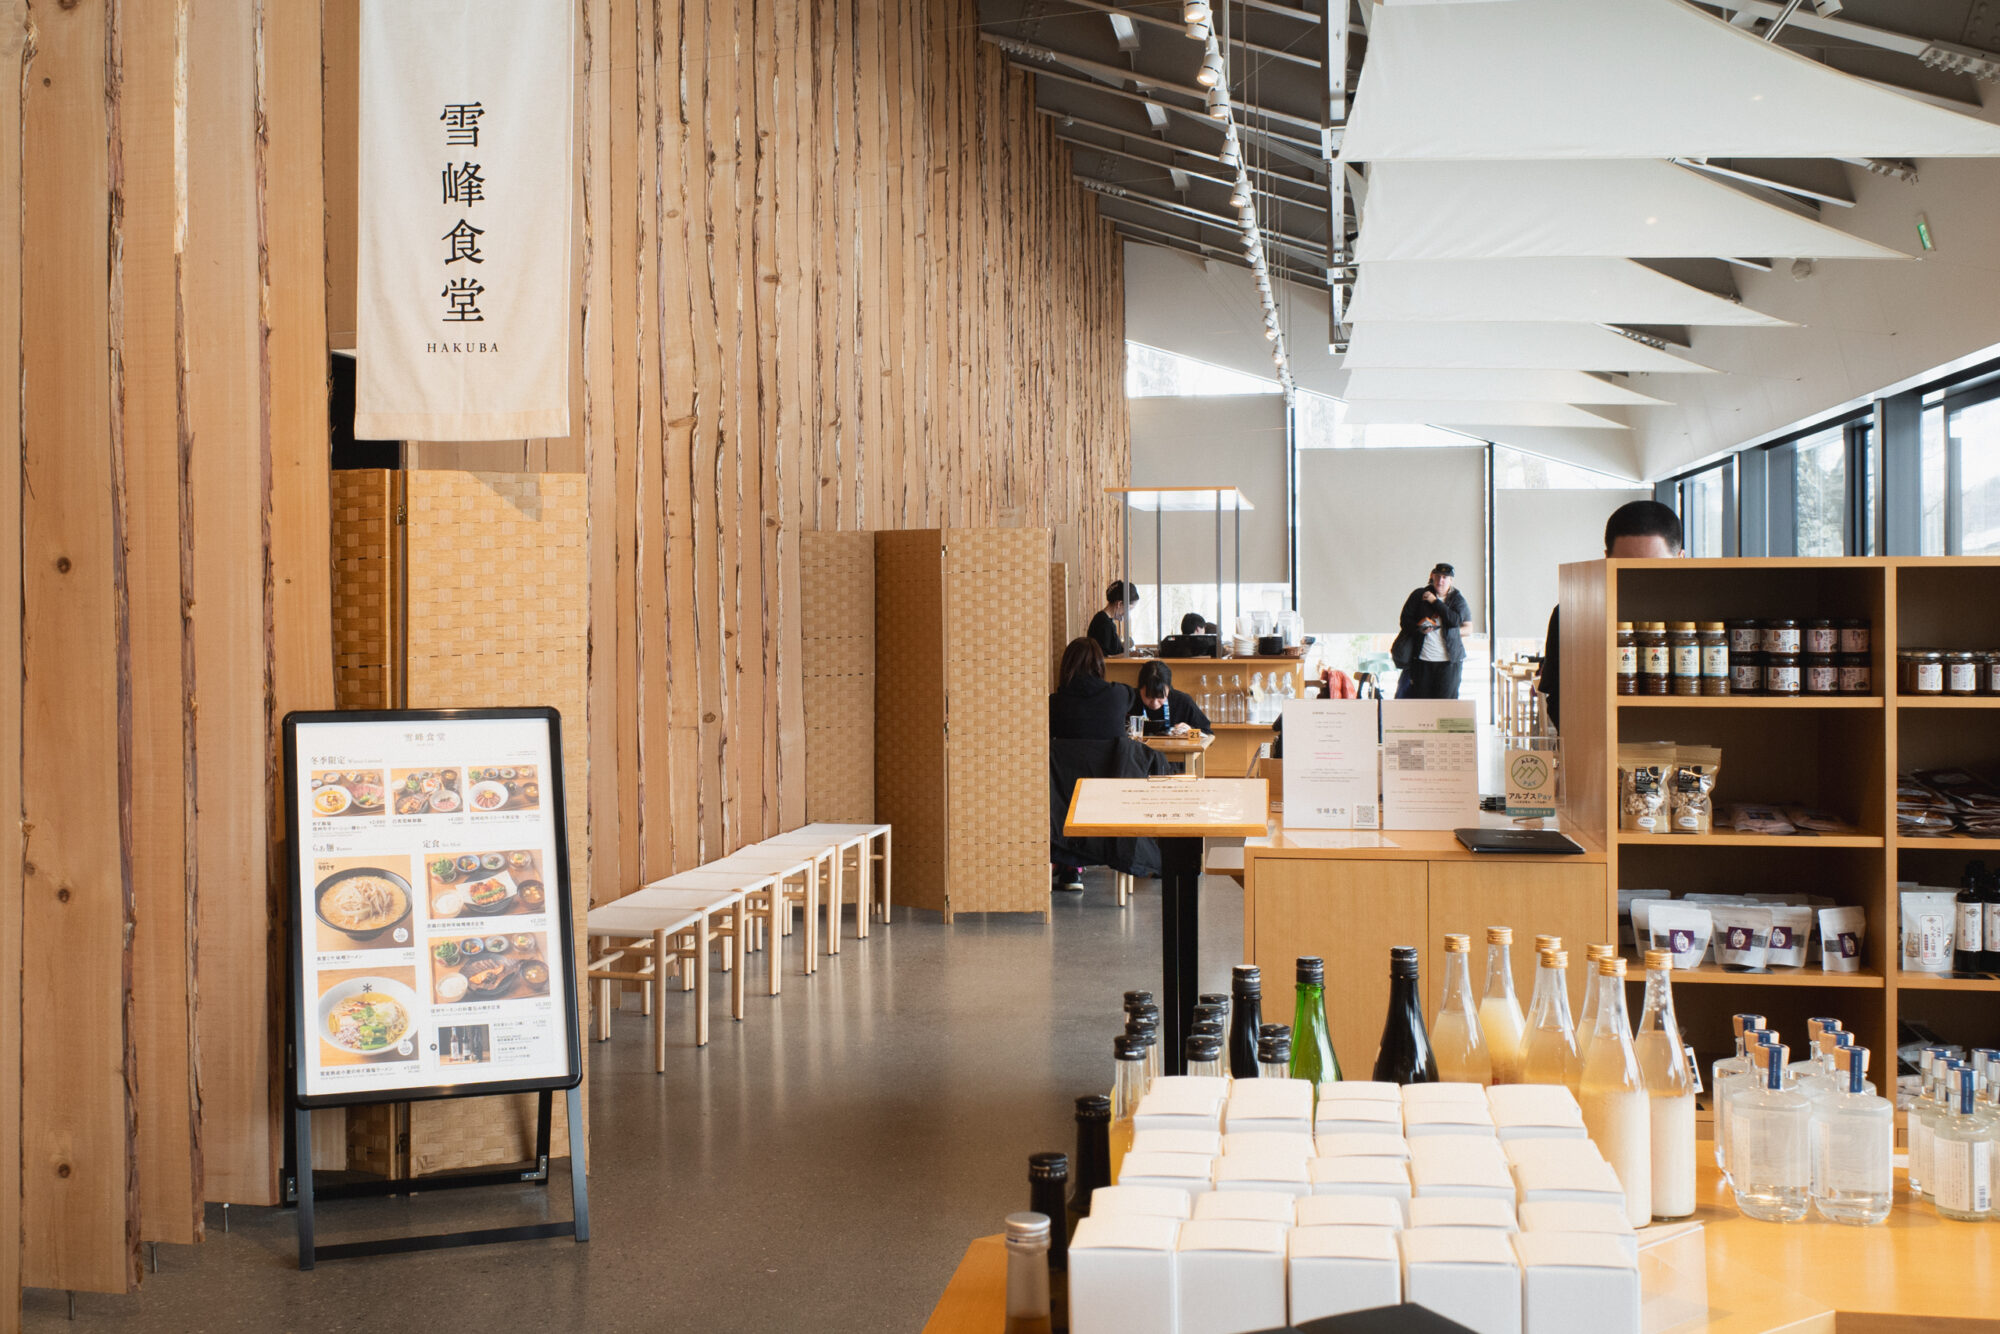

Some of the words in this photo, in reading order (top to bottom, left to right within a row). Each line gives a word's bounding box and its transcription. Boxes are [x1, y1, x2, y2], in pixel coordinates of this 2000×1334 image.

[439, 101, 485, 322] 雪峰食堂
[426, 342, 499, 353] HAKUBA
[311, 755, 345, 765] 冬季限定
[422, 840, 440, 848] 定食
